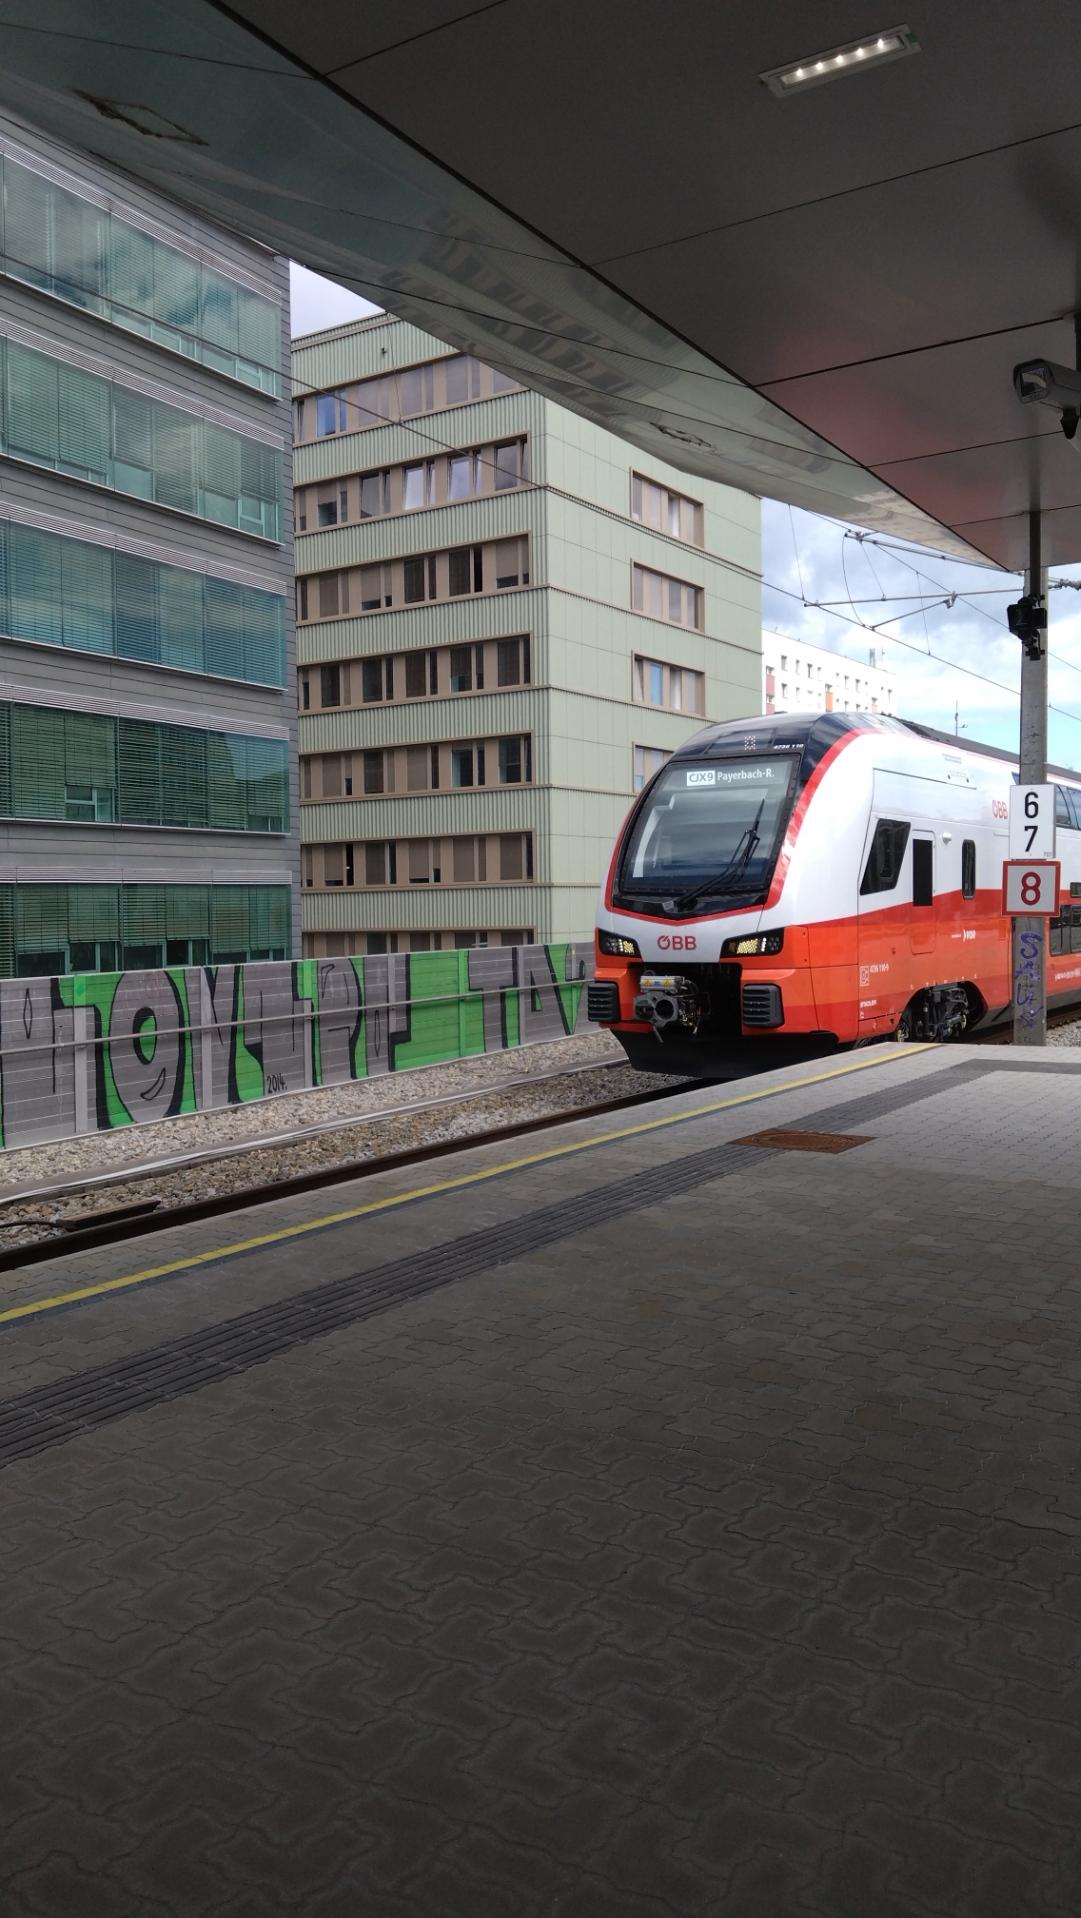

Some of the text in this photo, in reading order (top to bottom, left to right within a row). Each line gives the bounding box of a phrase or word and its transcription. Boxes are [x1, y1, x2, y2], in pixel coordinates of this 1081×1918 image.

[688, 768, 775, 783] CJX9 Payerbach-R.
[1024, 791, 1039, 819] 6
[1023, 825, 1039, 852] 7
[1020, 871, 1041, 906] 8
[657, 935, 697, 950] ÖBB
